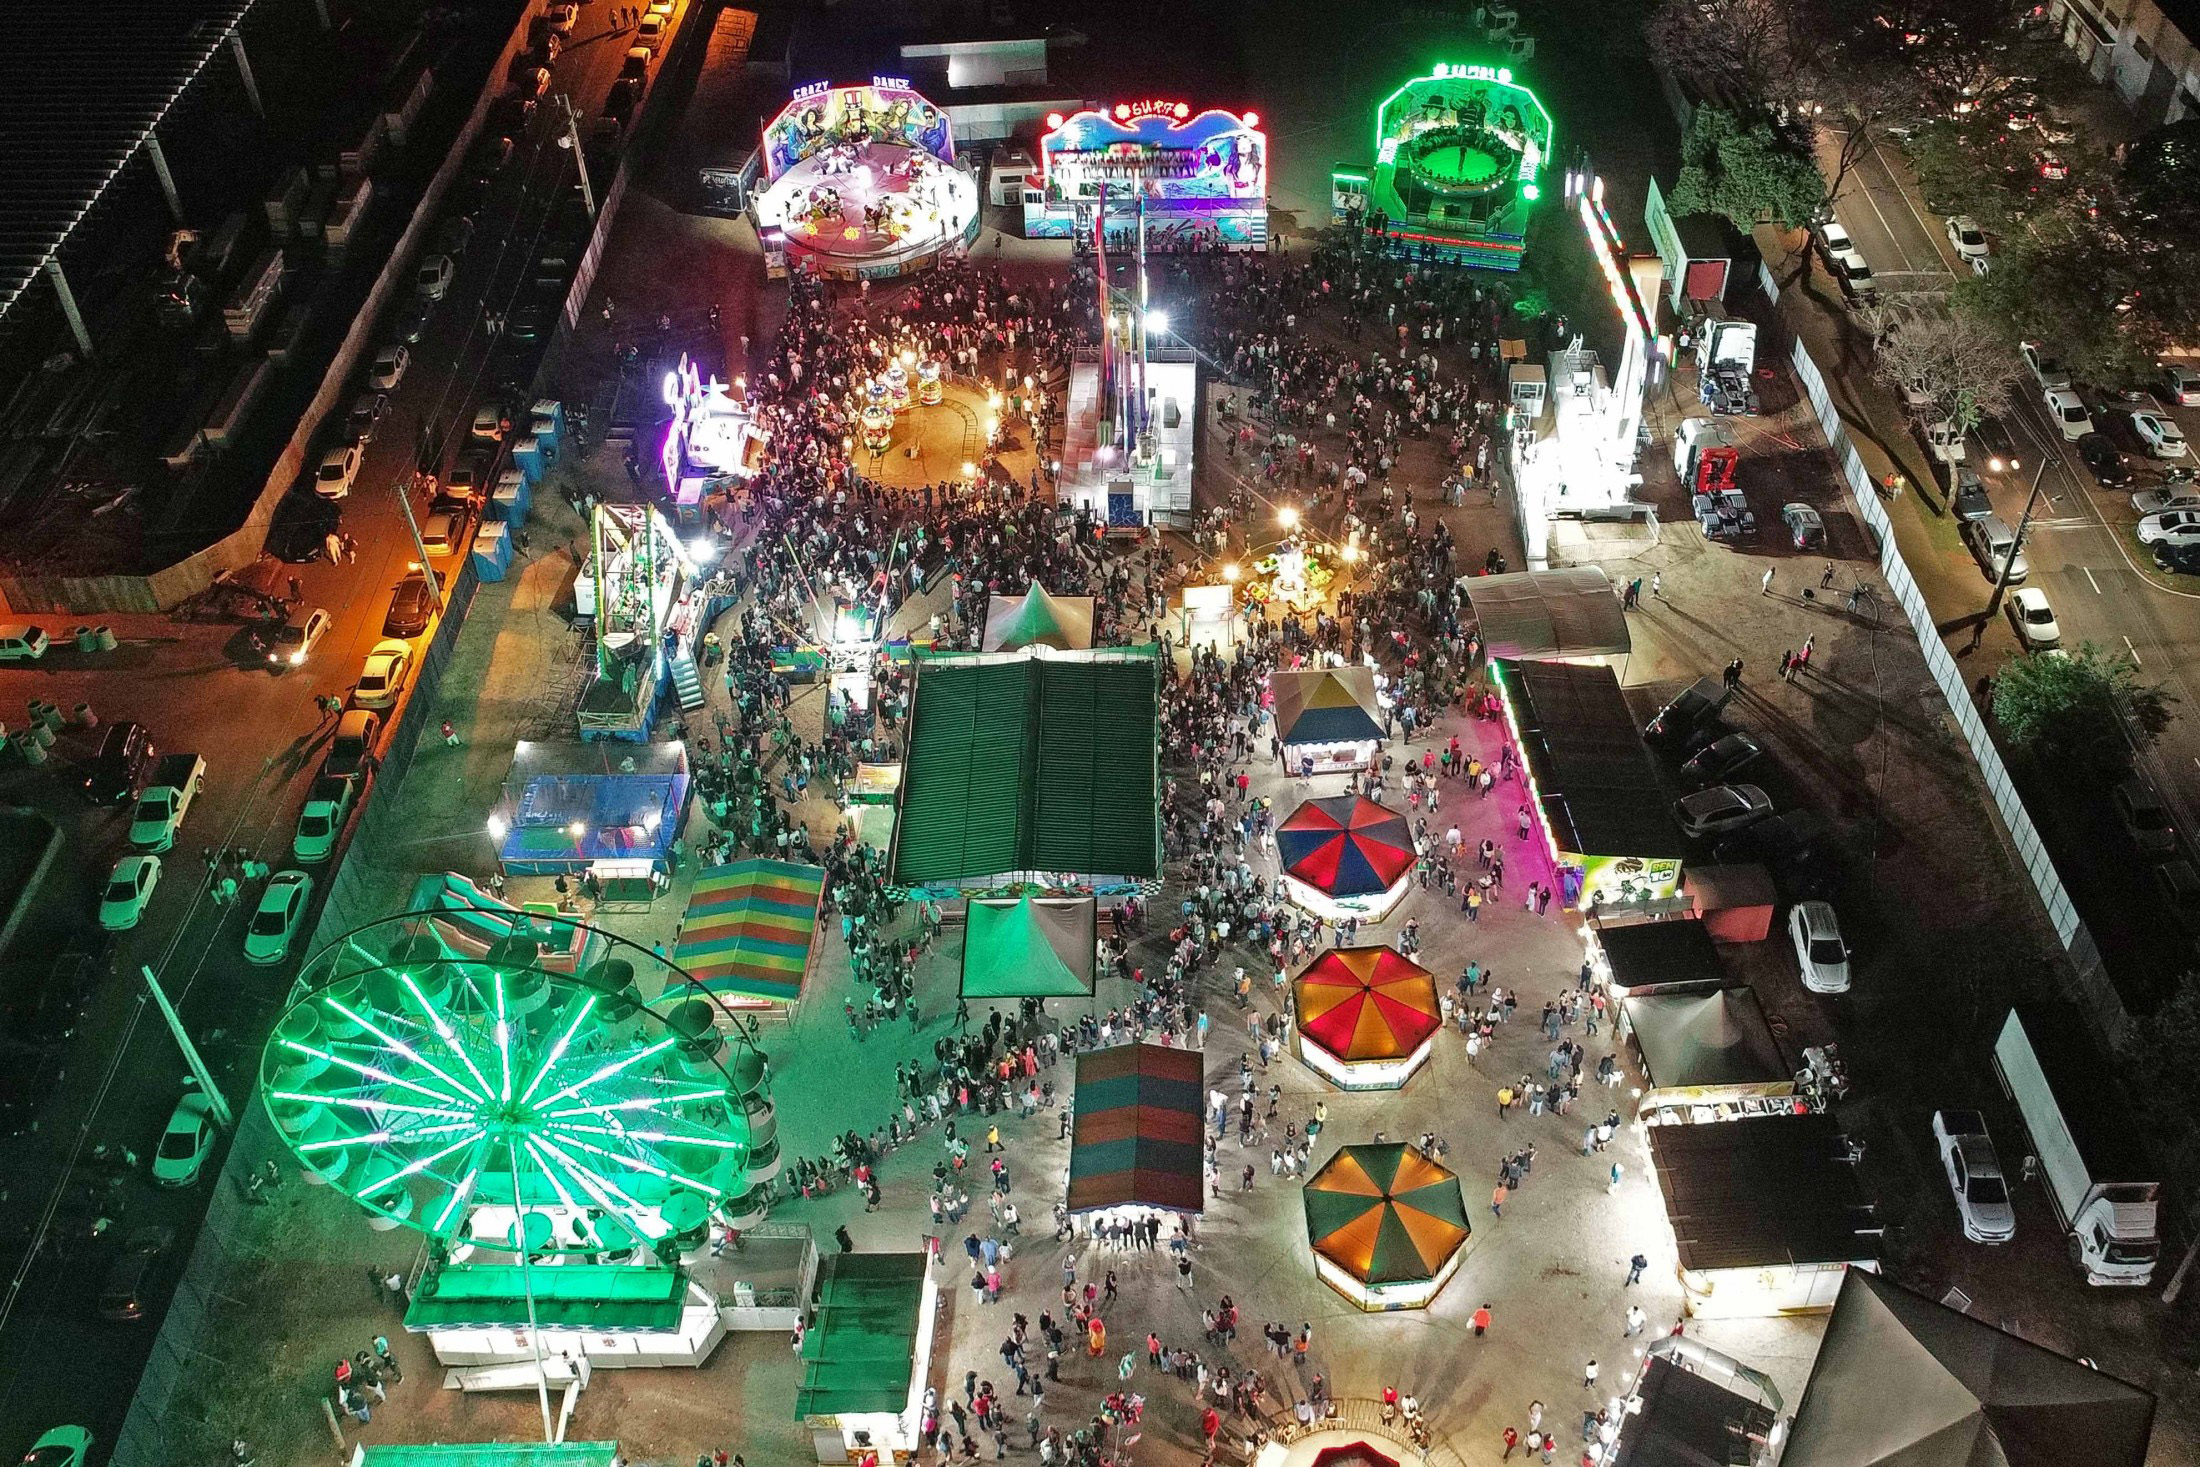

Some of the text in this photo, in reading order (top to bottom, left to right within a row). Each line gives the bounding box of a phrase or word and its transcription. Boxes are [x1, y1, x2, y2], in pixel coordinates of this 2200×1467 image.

[793, 76, 910, 100] CRAZY DANCE
[1132, 100, 1174, 115] SURF
[1652, 862, 1674, 871] BEN
[1650, 870, 1674, 882] 10
